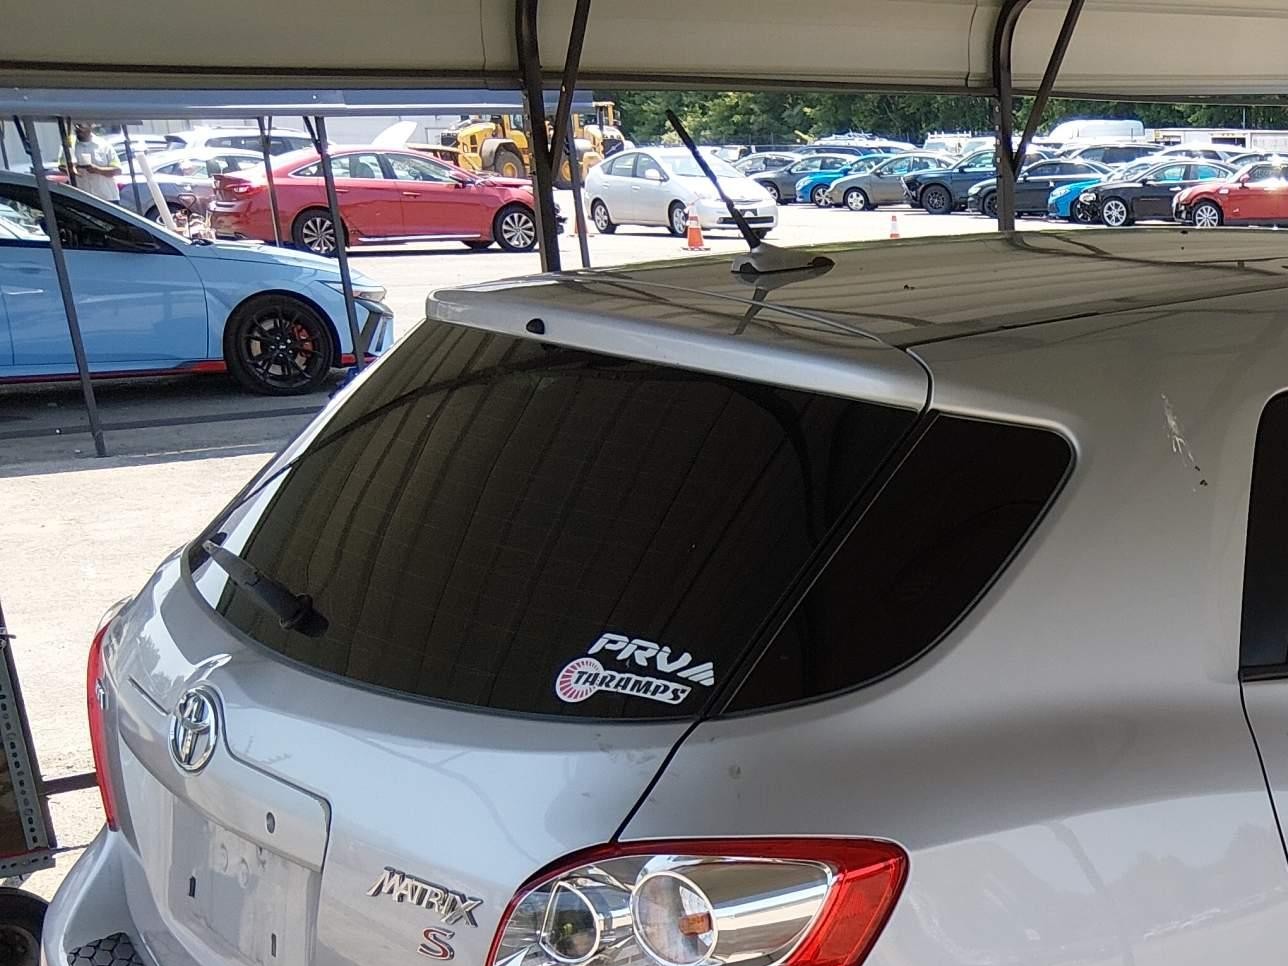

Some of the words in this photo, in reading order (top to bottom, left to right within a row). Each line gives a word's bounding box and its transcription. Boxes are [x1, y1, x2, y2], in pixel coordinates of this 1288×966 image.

[573, 670, 688, 701] TARAMPS
[366, 866, 484, 928] MATRIX
[417, 926, 456, 961] S
